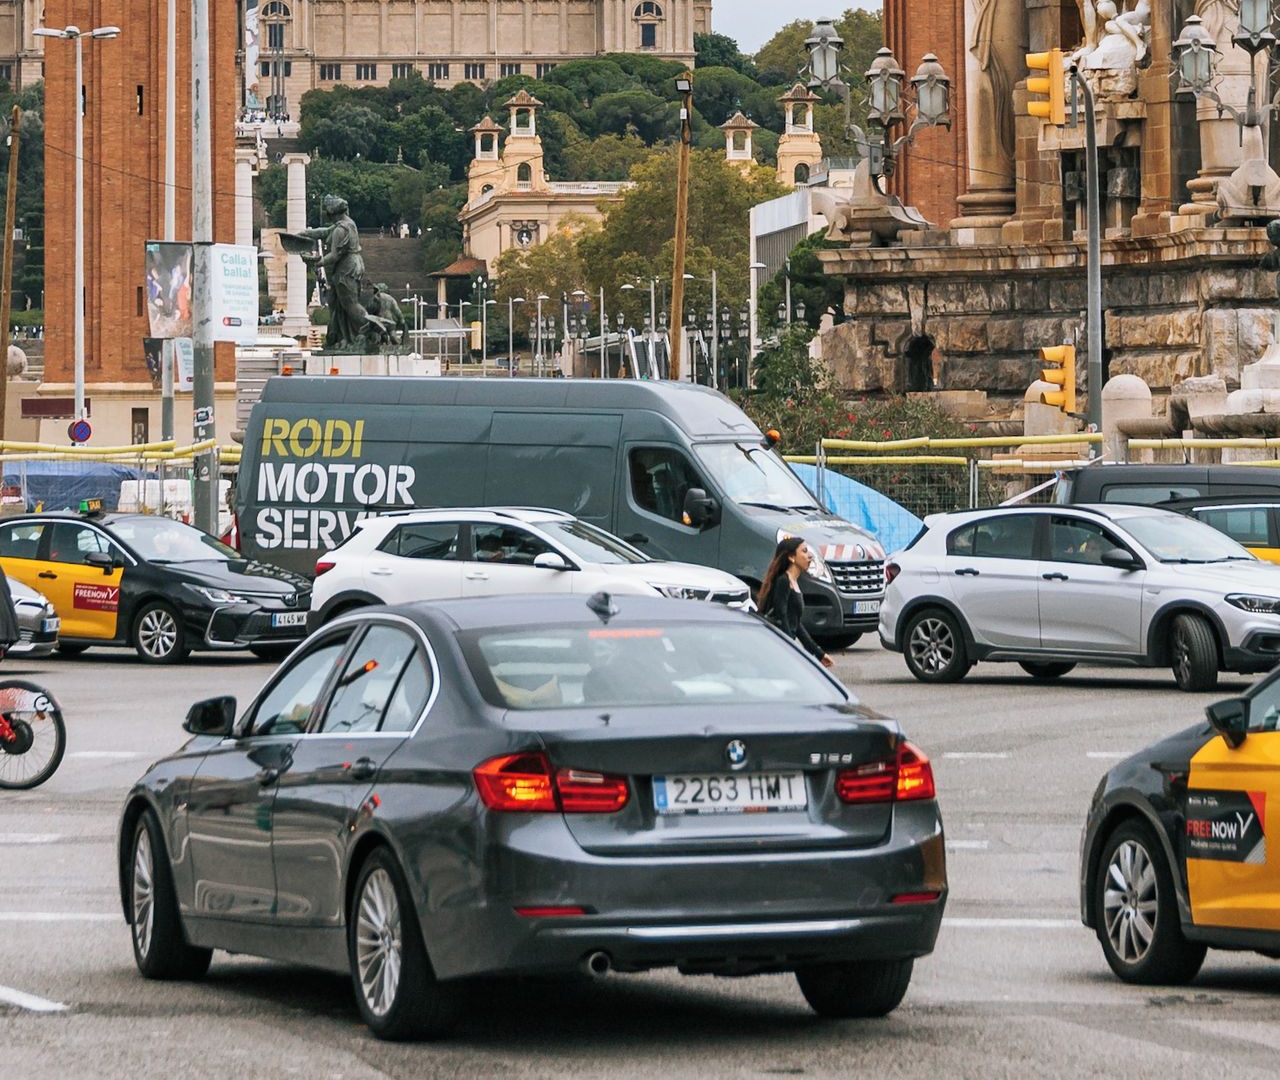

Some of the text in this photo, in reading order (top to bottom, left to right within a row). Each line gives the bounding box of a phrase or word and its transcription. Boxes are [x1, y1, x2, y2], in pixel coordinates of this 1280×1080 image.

[221, 253, 247, 265] Calla
[224, 267, 252, 278] balla!
[261, 418, 365, 458] RODI
[257, 462, 416, 505] MOTOR
[255, 507, 377, 550] SERV
[673, 774, 796, 804] 2263 HMT
